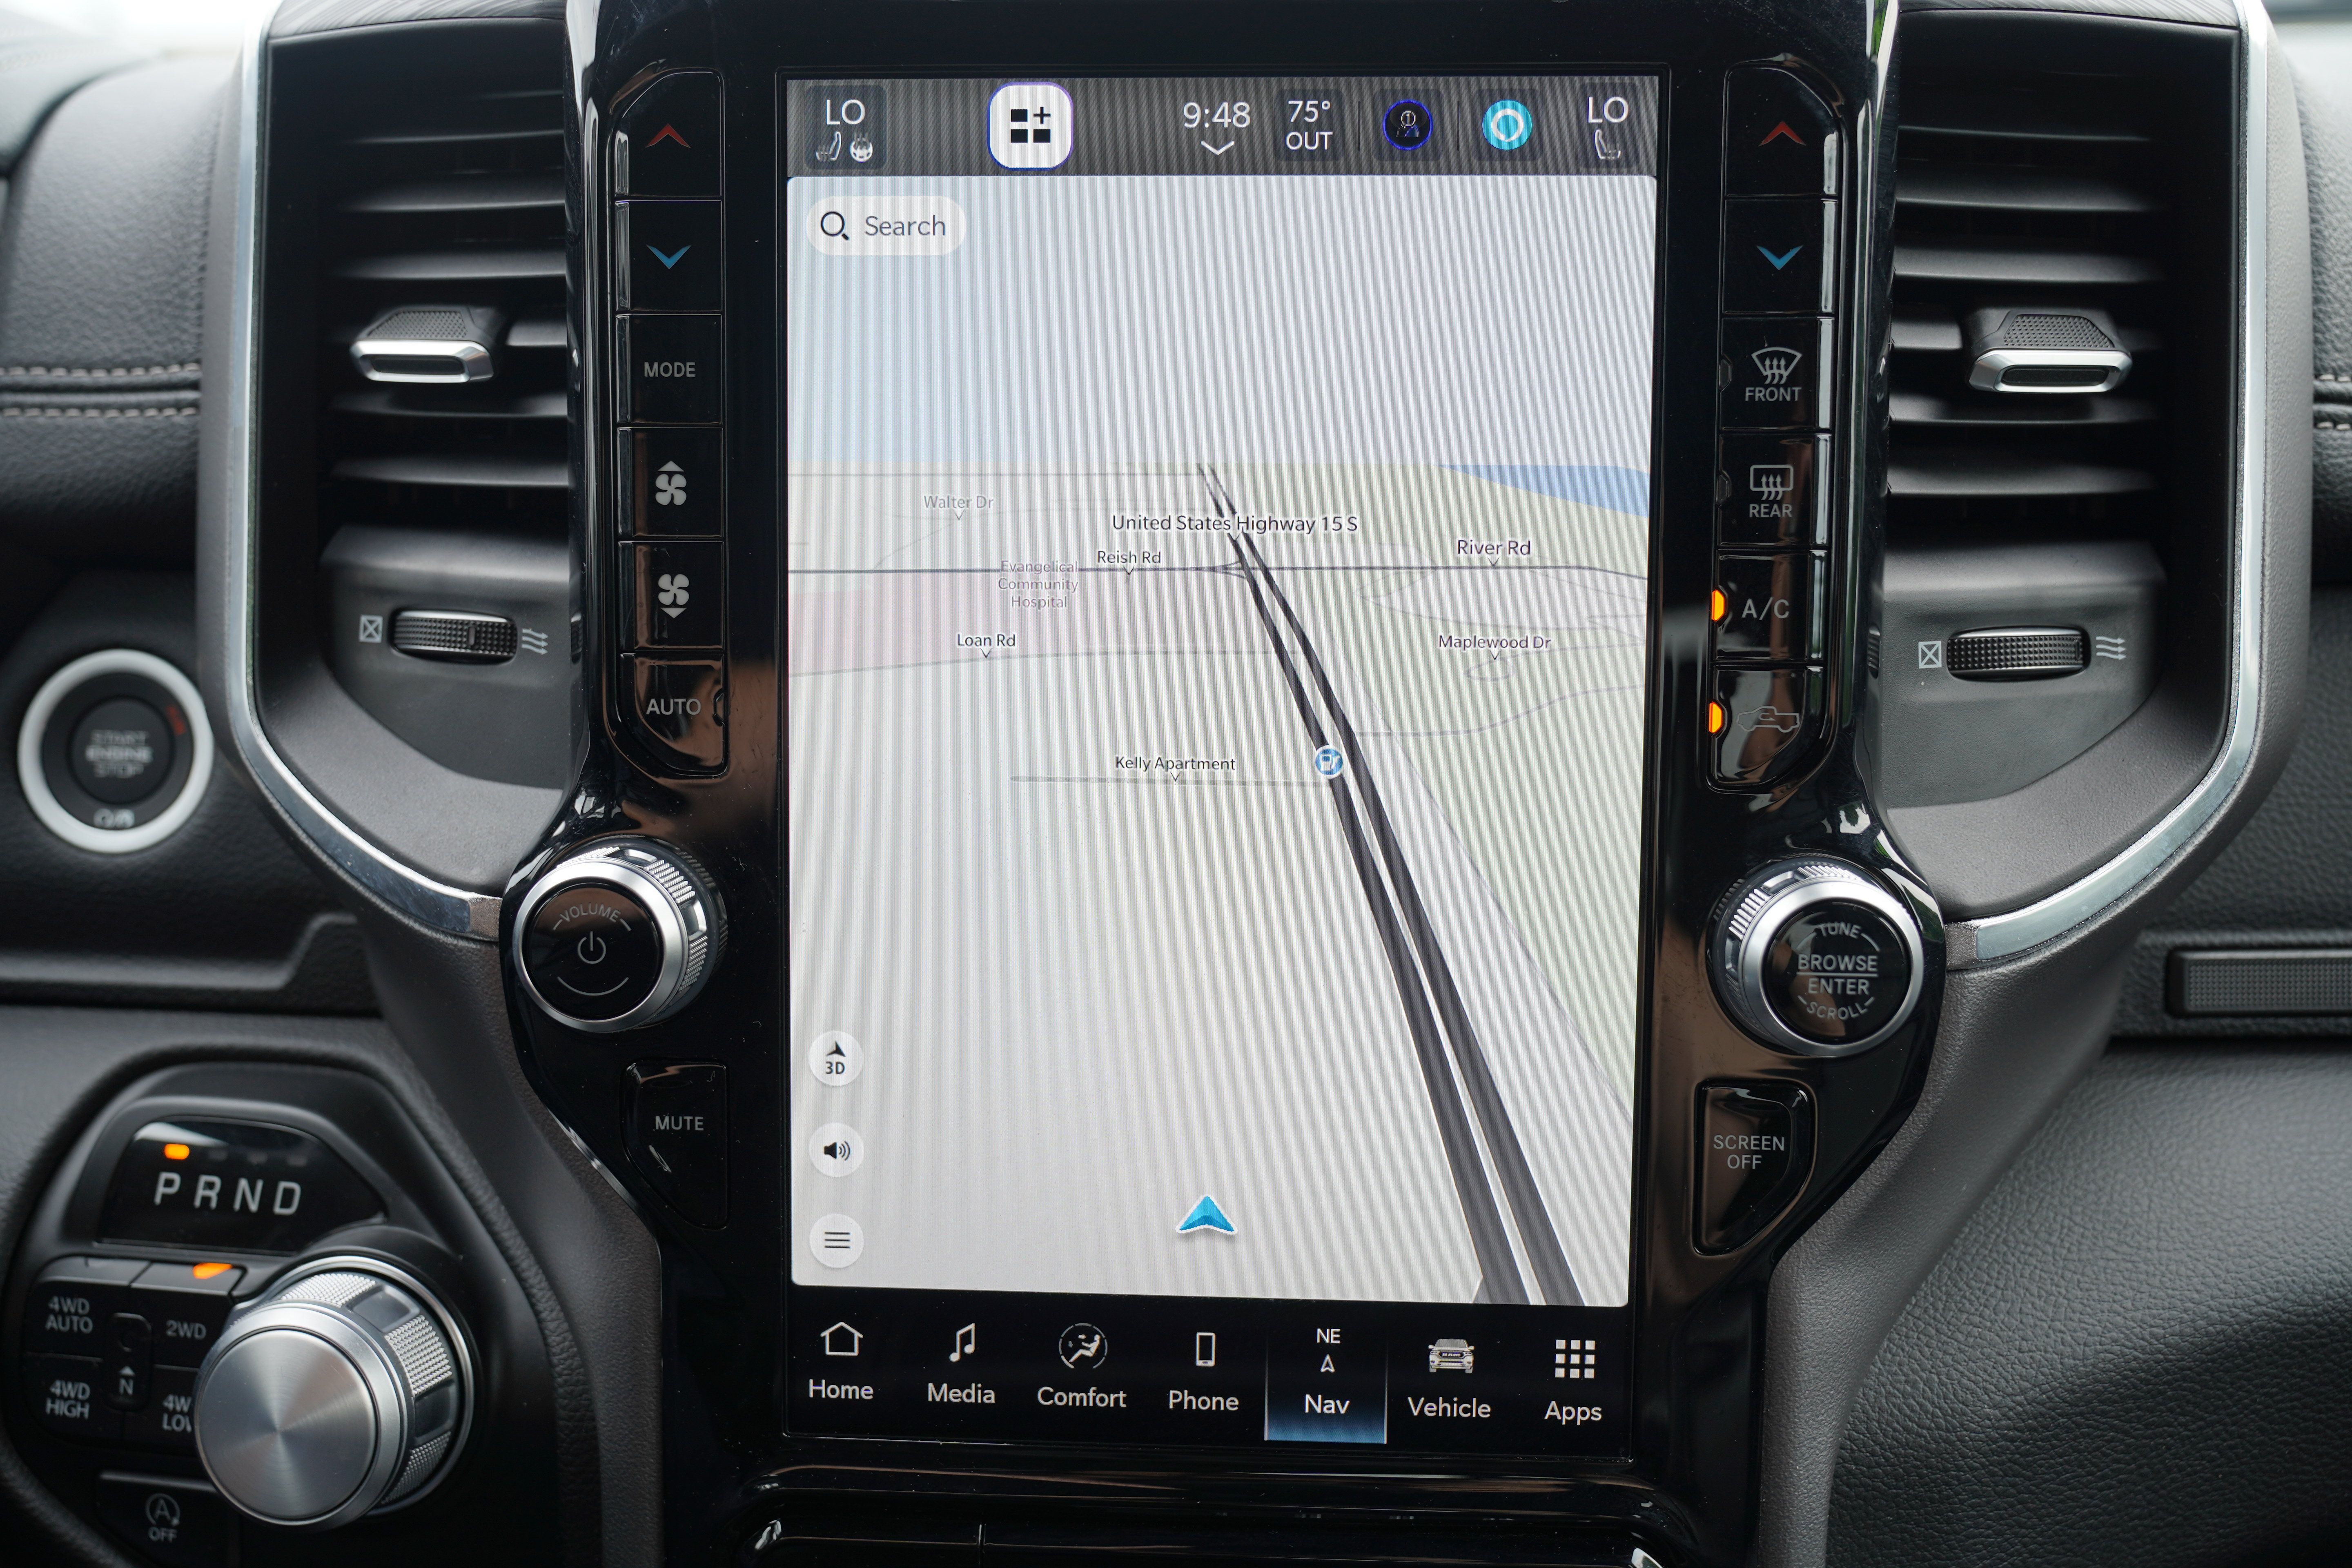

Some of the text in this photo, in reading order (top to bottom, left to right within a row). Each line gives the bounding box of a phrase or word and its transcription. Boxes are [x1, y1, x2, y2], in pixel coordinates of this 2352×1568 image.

[825, 99, 865, 126] LO
[1183, 102, 1251, 128] 9:48
[1288, 100, 1331, 122] 75°
[1588, 97, 1628, 123] LO
[1285, 131, 1333, 152] OUT
[864, 215, 946, 237] Search
[644, 362, 696, 377] MODE
[1745, 387, 1802, 402] FRONT
[924, 495, 993, 509] Walter Dr
[1749, 504, 1792, 517] REAR
[1113, 514, 1358, 534] United States Highway 15 S
[1457, 540, 1530, 555] River Rd
[1097, 551, 1161, 564] Reish Rd
[1001, 561, 1078, 575] Evangelical
[998, 578, 1078, 592] Community
[1011, 596, 1067, 609] Hospital
[1742, 597, 1789, 620] A/C
[957, 633, 1015, 647] Loan Rd
[1439, 635, 1551, 650] Maplewood Dr
[646, 698, 701, 715] AUTO
[1116, 756, 1236, 771] Kelly Apartment
[559, 903, 621, 923] VOLUME
[1817, 921, 1860, 940] TUNE
[1798, 953, 1877, 973] BROWSE
[1808, 977, 1869, 994] ENTER
[1807, 1000, 1867, 1020] SCROLL
[825, 1061, 845, 1075] 3D
[655, 1116, 704, 1131] MUTE
[1713, 1134, 1784, 1150] SCREEN
[1727, 1154, 1762, 1169] OFF
[49, 1296, 90, 1315] 4WD
[45, 1314, 93, 1333] AUTO
[166, 1320, 207, 1340] 2WD
[1316, 1329, 1340, 1343] NE
[50, 1380, 90, 1401] 4WD
[119, 1378, 133, 1395] N
[809, 1381, 873, 1400] Home
[928, 1383, 995, 1404] Media
[163, 1394, 192, 1412] 4W
[1037, 1387, 1126, 1407] Comfort
[1169, 1390, 1239, 1412] Phone
[1305, 1395, 1349, 1414] Nav
[46, 1398, 89, 1419] HIGH
[1408, 1397, 1491, 1418] Vehicle
[1545, 1401, 1601, 1425] Apps
[148, 1527, 177, 1541] OFF
